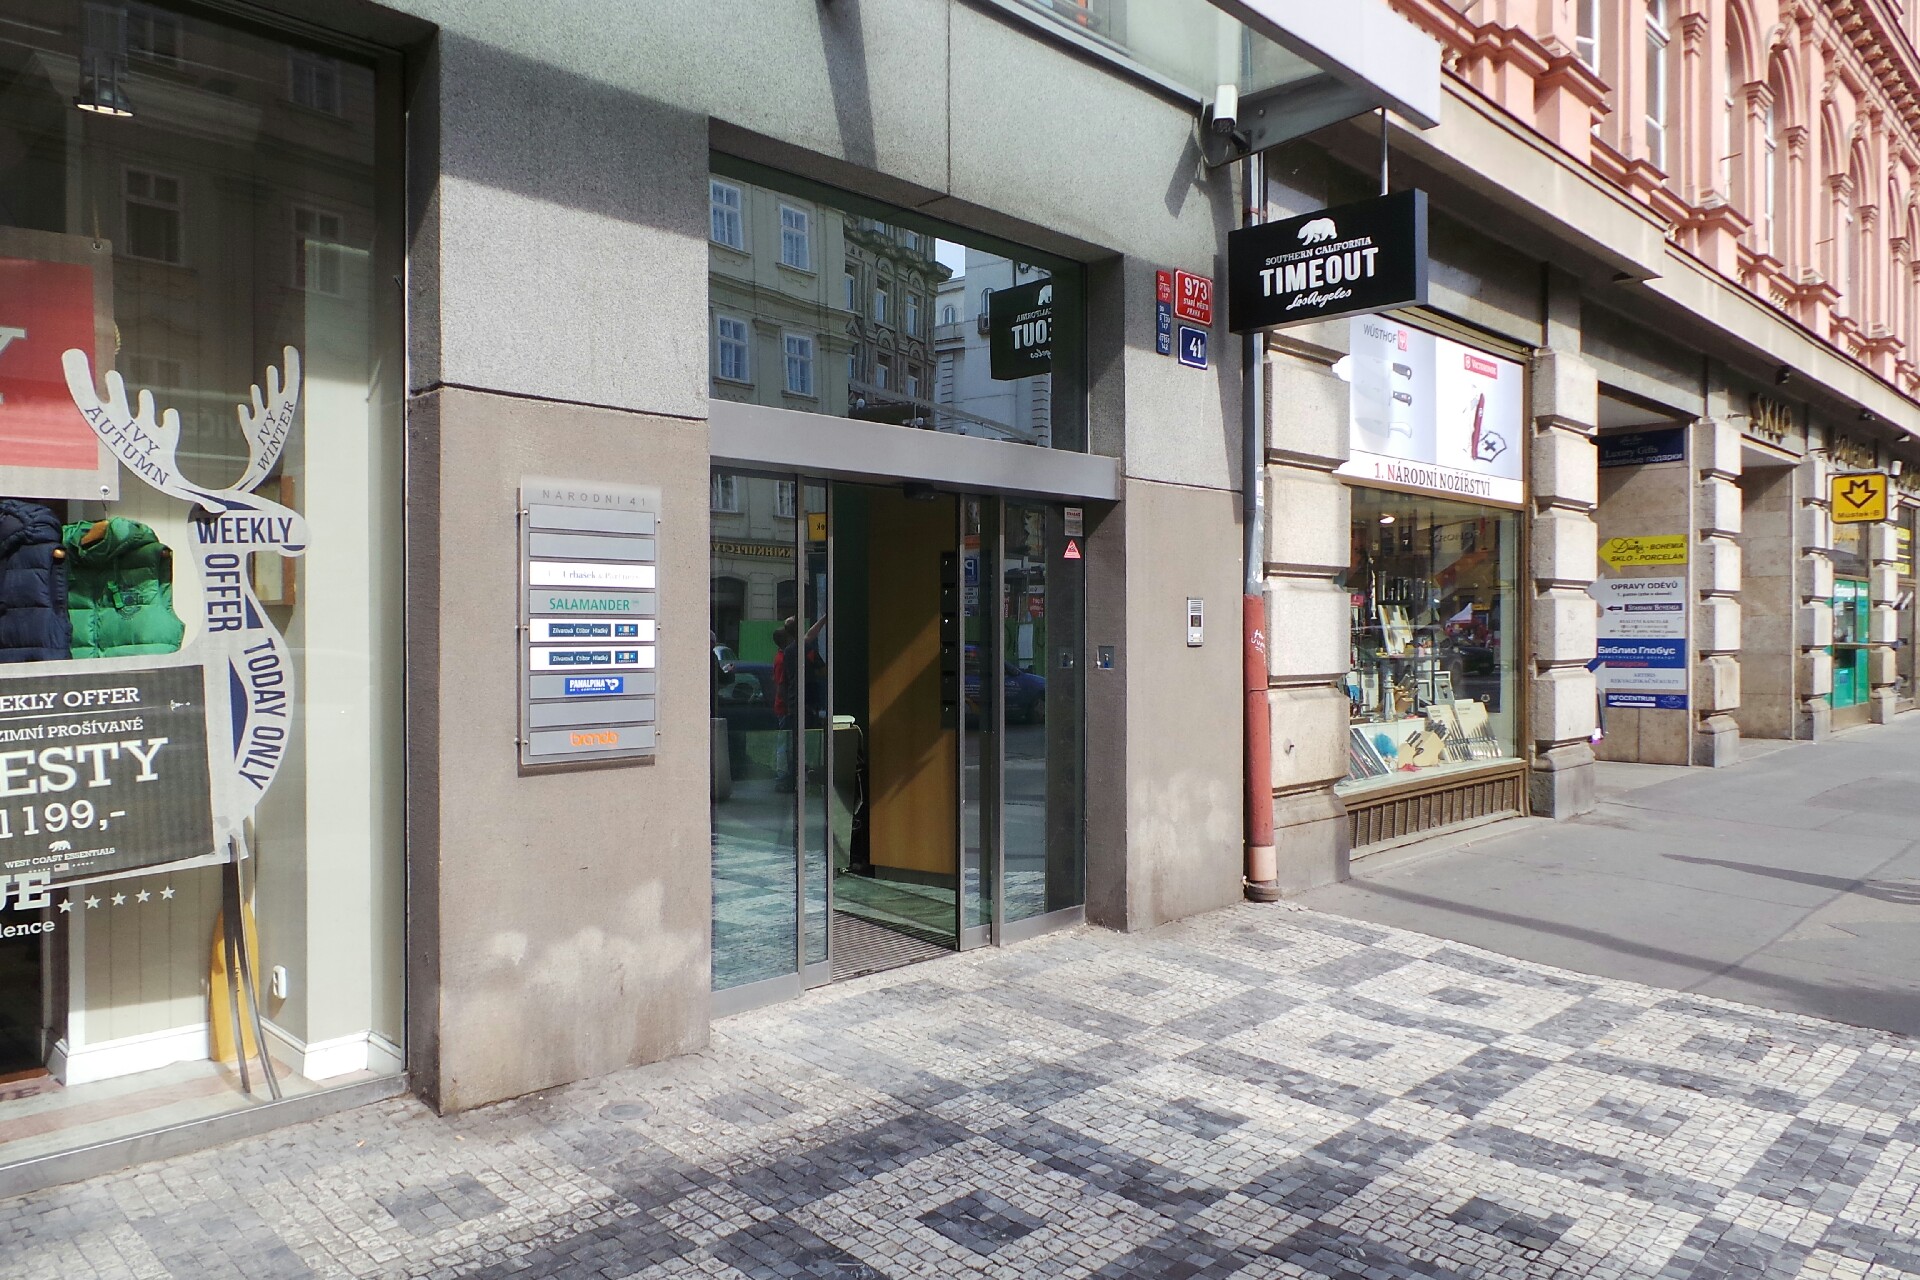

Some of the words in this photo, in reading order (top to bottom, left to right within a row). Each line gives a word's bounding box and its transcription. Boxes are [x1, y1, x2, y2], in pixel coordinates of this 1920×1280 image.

[1265, 248, 1313, 266] SOUTHERN
[1315, 236, 1372, 256] CALIFORNIA
[1259, 246, 1379, 298] TIMEOUT
[1184, 277, 1208, 301] 973
[1186, 307, 1201, 318] PRAHA
[1189, 337, 1202, 358] 41
[122, 419, 160, 456] IVY
[257, 409, 277, 445] IVY
[257, 401, 295, 472] WINTER
[84, 405, 171, 486] AUTUMN
[1374, 462, 1384, 479] 1.
[1387, 461, 1437, 488] NÁRODNÍ
[1439, 471, 1491, 496] NOŽÍŘSTVÍ
[629, 497, 646, 506] 41
[195, 517, 293, 544] WEEKLY
[1650, 542, 1684, 550] BOHEMIA
[204, 553, 243, 633] OFFER
[550, 597, 630, 611] SALAMANDER
[1598, 646, 1637, 654] Библио
[1638, 646, 1676, 655] Глобус
[243, 637, 287, 718] TODAY
[569, 678, 606, 688] PANALPINA
[63, 687, 140, 707] OFFER
[1608, 694, 1656, 702] INFOCENTRUM
[47, 716, 143, 739] PROŠÍVANÉ
[238, 727, 285, 791] ONLY
[4, 858, 31, 869] WEST
[32, 854, 63, 865] COAST
[64, 847, 116, 861] ESSENTIALS
